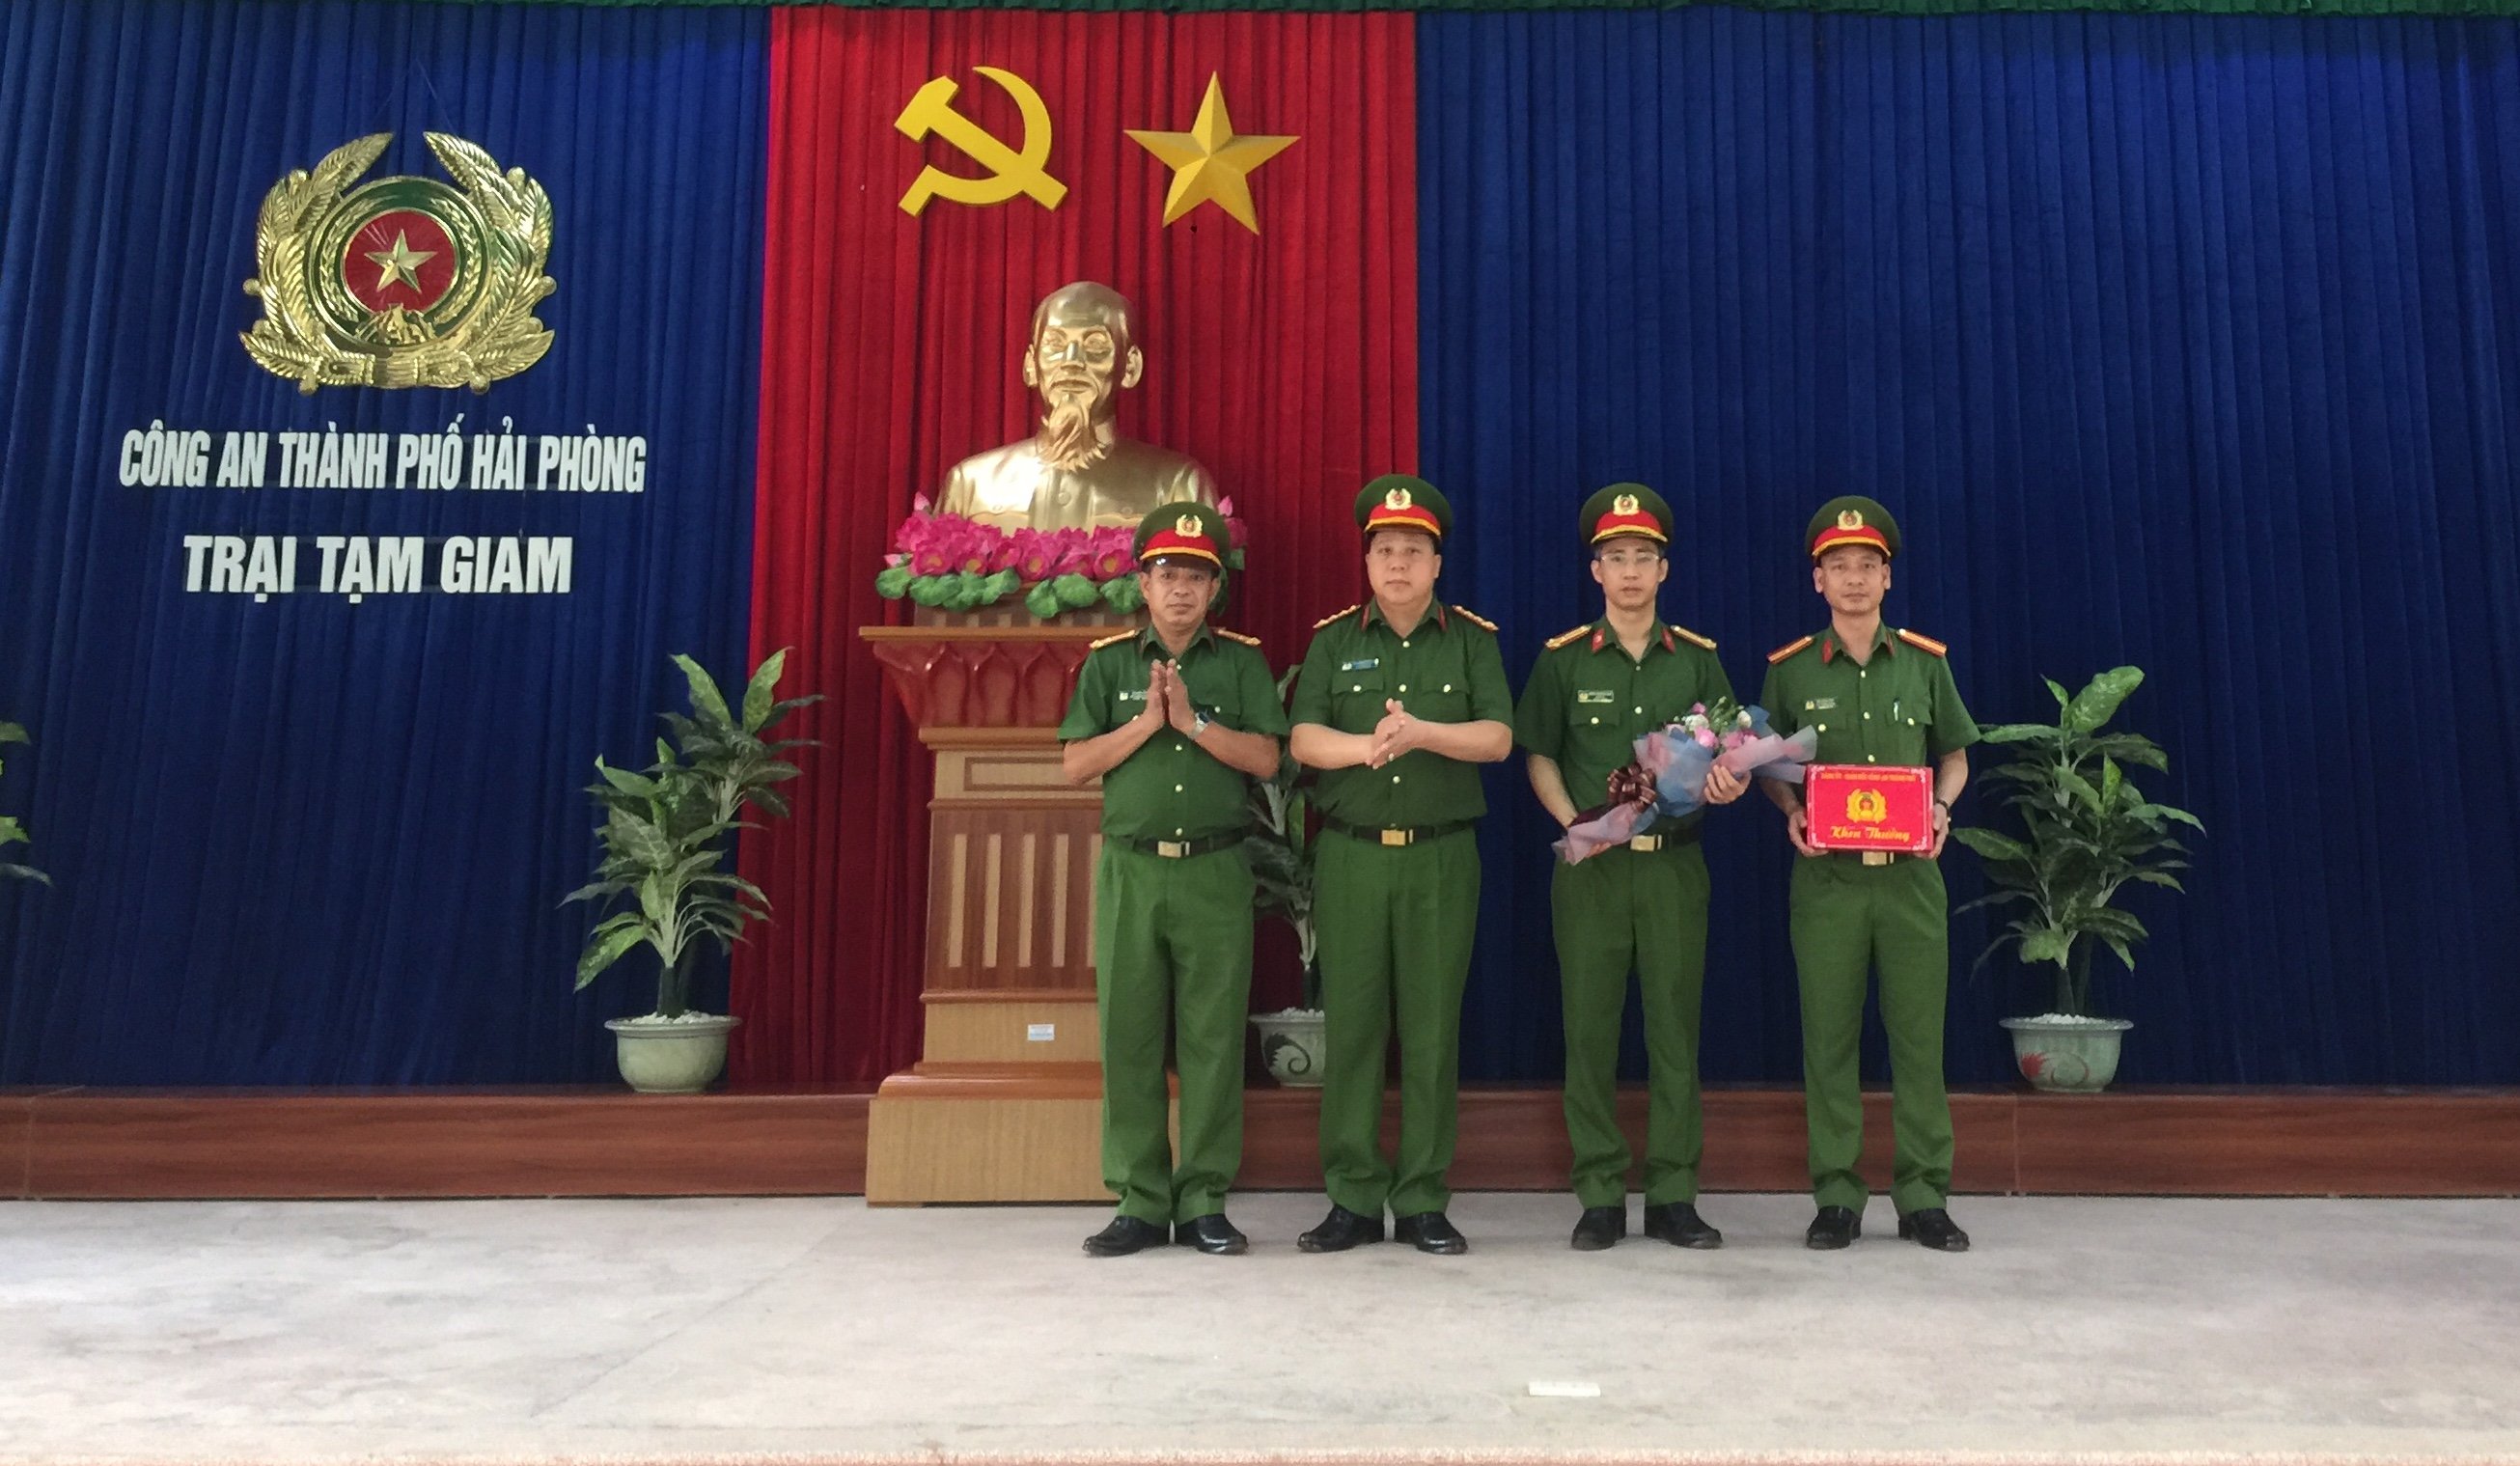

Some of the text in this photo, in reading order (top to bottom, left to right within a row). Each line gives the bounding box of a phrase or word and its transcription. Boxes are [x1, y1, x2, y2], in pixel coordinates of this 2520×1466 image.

[119, 412, 647, 493] CÔNG AN THÀNH PHỐ HẢI PHÒNG
[182, 535, 573, 604] TRẠI TẠM GIAM
